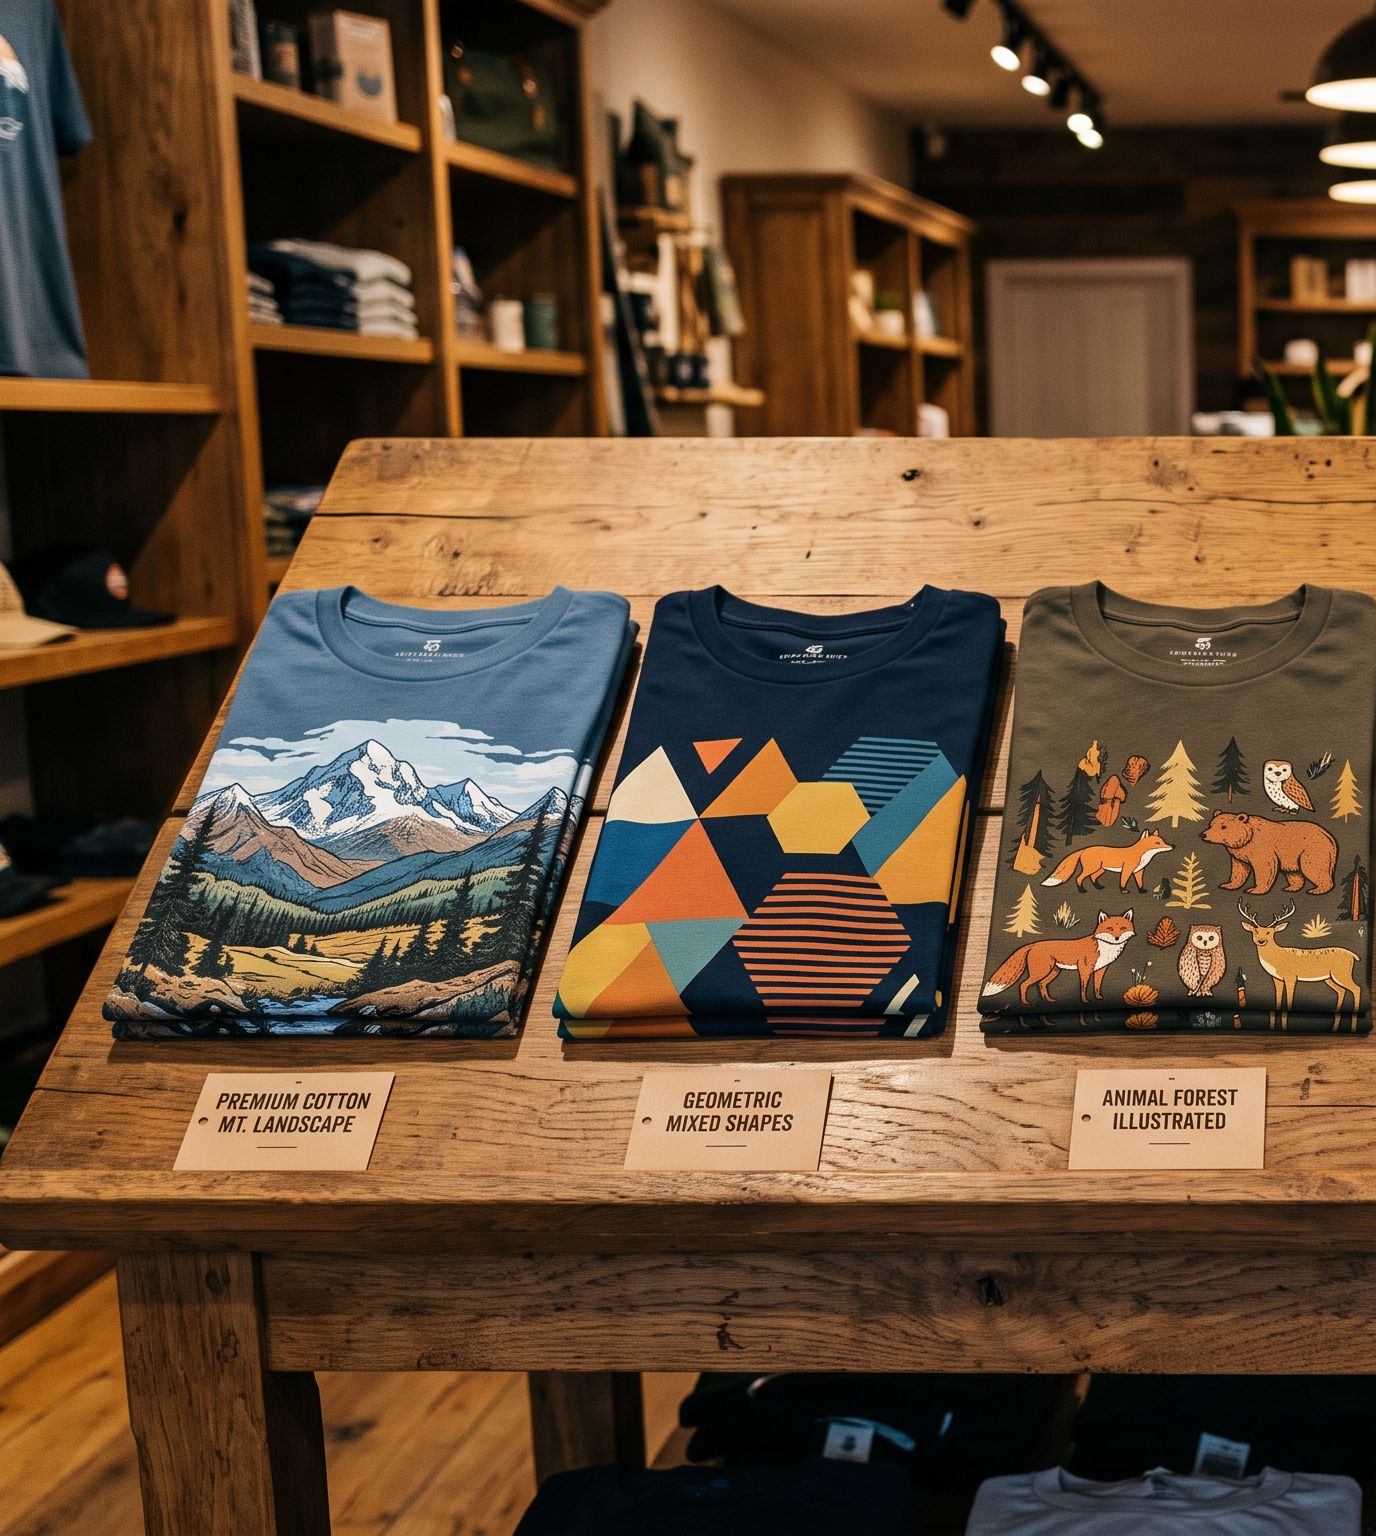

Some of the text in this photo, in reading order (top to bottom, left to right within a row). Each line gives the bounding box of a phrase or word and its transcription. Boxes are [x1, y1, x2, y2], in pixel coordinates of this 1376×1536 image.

[216, 1093, 371, 1110] PREMIUM COTTON
[684, 1091, 782, 1108] GEOMETRIC
[1103, 1089, 1238, 1106] ANIMAL FOREST
[218, 1116, 356, 1133] MT. LANDSCAPE
[666, 1114, 793, 1131] MIXED SHAPES
[1113, 1113, 1225, 1129] ILLUSTRATED
